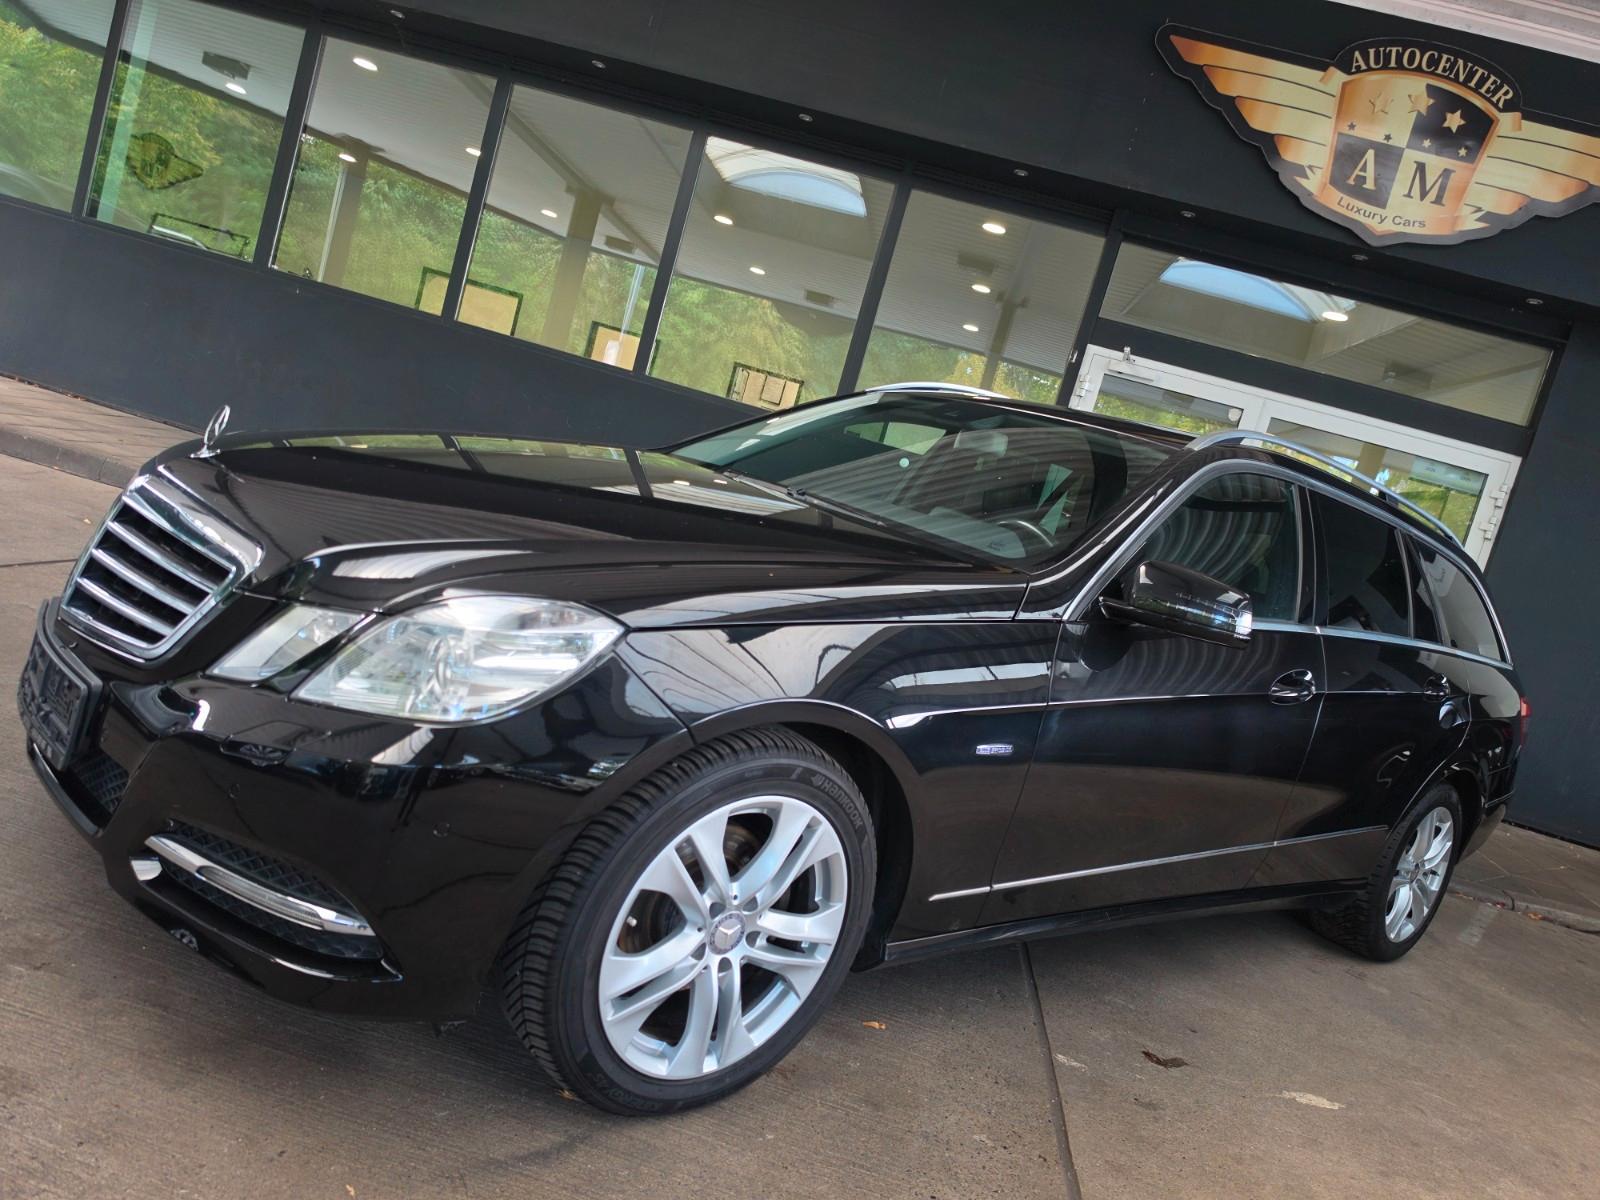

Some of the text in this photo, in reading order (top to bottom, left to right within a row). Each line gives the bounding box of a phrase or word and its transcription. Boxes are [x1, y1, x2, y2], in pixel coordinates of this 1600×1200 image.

[1351, 46, 1514, 109] AUTOCENTER
[1346, 148, 1456, 207] A M
[1337, 196, 1427, 228] Luxury Cars
